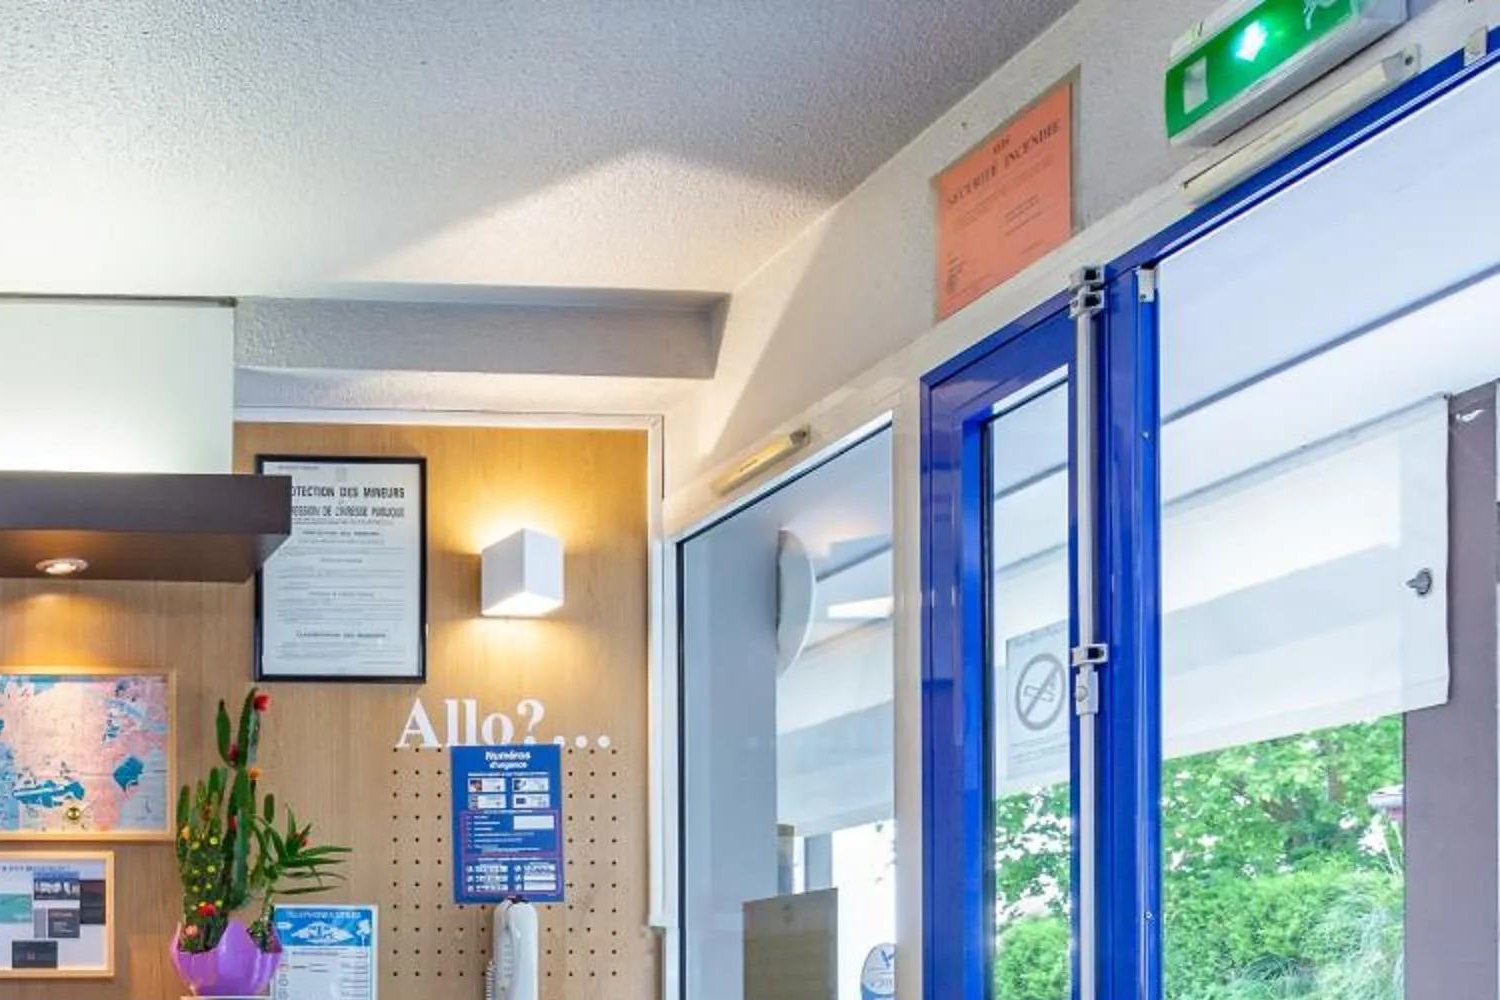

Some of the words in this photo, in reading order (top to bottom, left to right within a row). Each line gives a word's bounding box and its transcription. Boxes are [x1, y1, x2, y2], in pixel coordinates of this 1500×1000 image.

[340, 487, 359, 497] DES
[363, 487, 405, 499] MINEURS
[323, 506, 332, 516] DE
